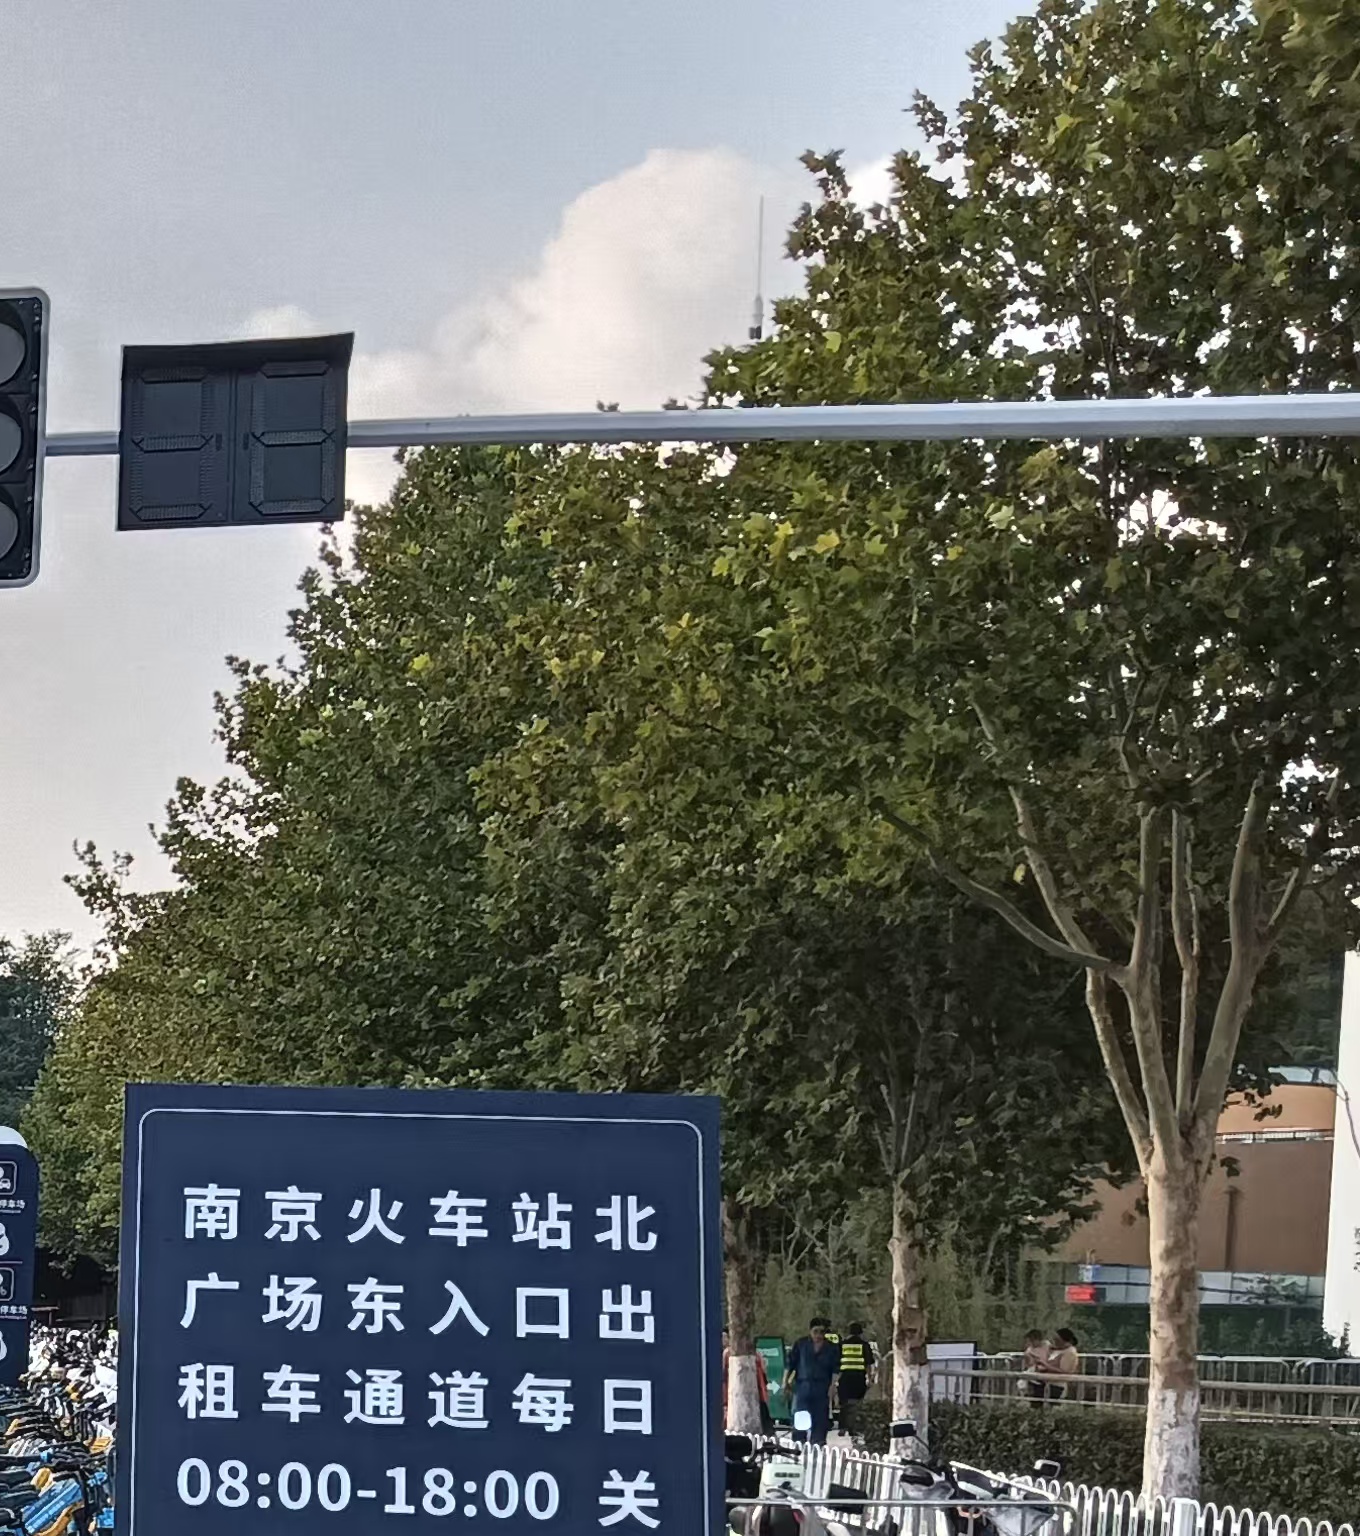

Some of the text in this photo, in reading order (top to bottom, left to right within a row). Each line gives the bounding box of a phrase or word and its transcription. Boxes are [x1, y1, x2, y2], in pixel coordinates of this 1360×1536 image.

[183, 1183, 658, 1251] 南京火车站北
[179, 1271, 655, 1344] 广场东入口出
[177, 1362, 653, 1435] 租车通道每日
